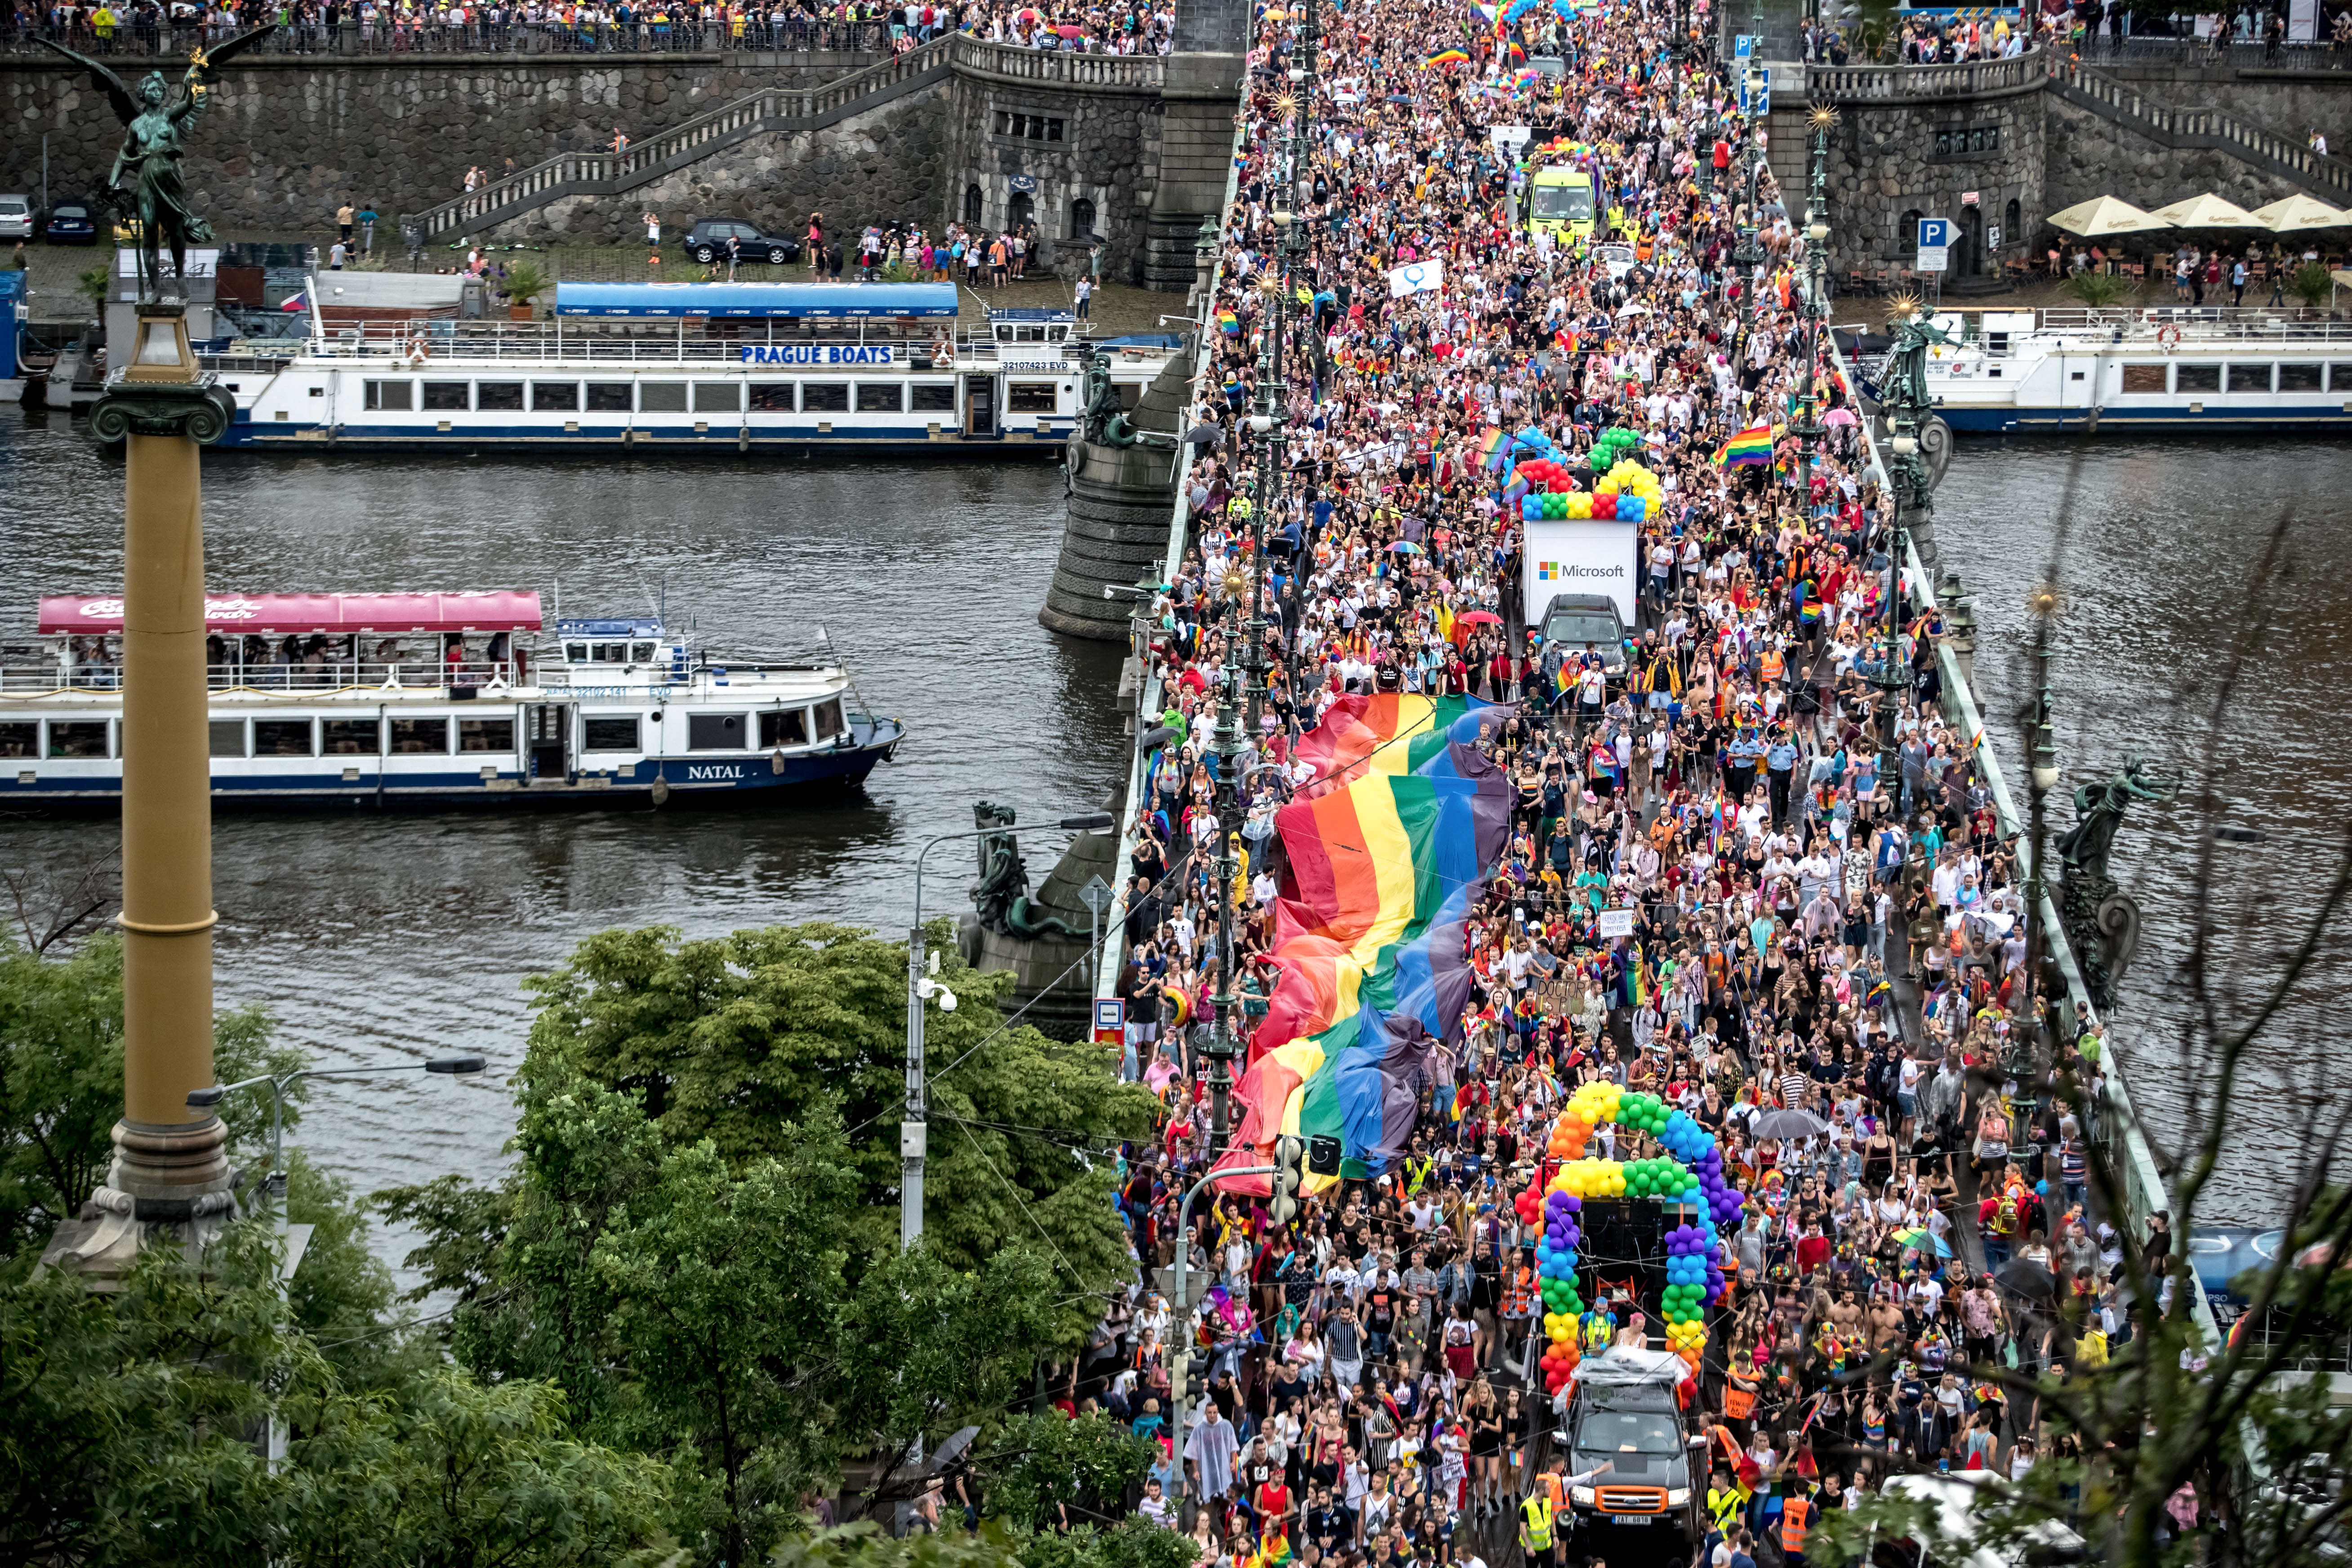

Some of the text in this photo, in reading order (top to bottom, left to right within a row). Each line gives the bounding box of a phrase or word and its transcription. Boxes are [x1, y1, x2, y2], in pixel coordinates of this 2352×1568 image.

[1739, 39, 1748, 50] P
[1927, 225, 1940, 242] P
[742, 347, 891, 363] PRAGUE BOATS
[1562, 565, 1624, 577] Microsoft
[650, 686, 671, 696] EVD
[688, 766, 745, 779] NATAL
[1537, 980, 1585, 999] DOCTOR
